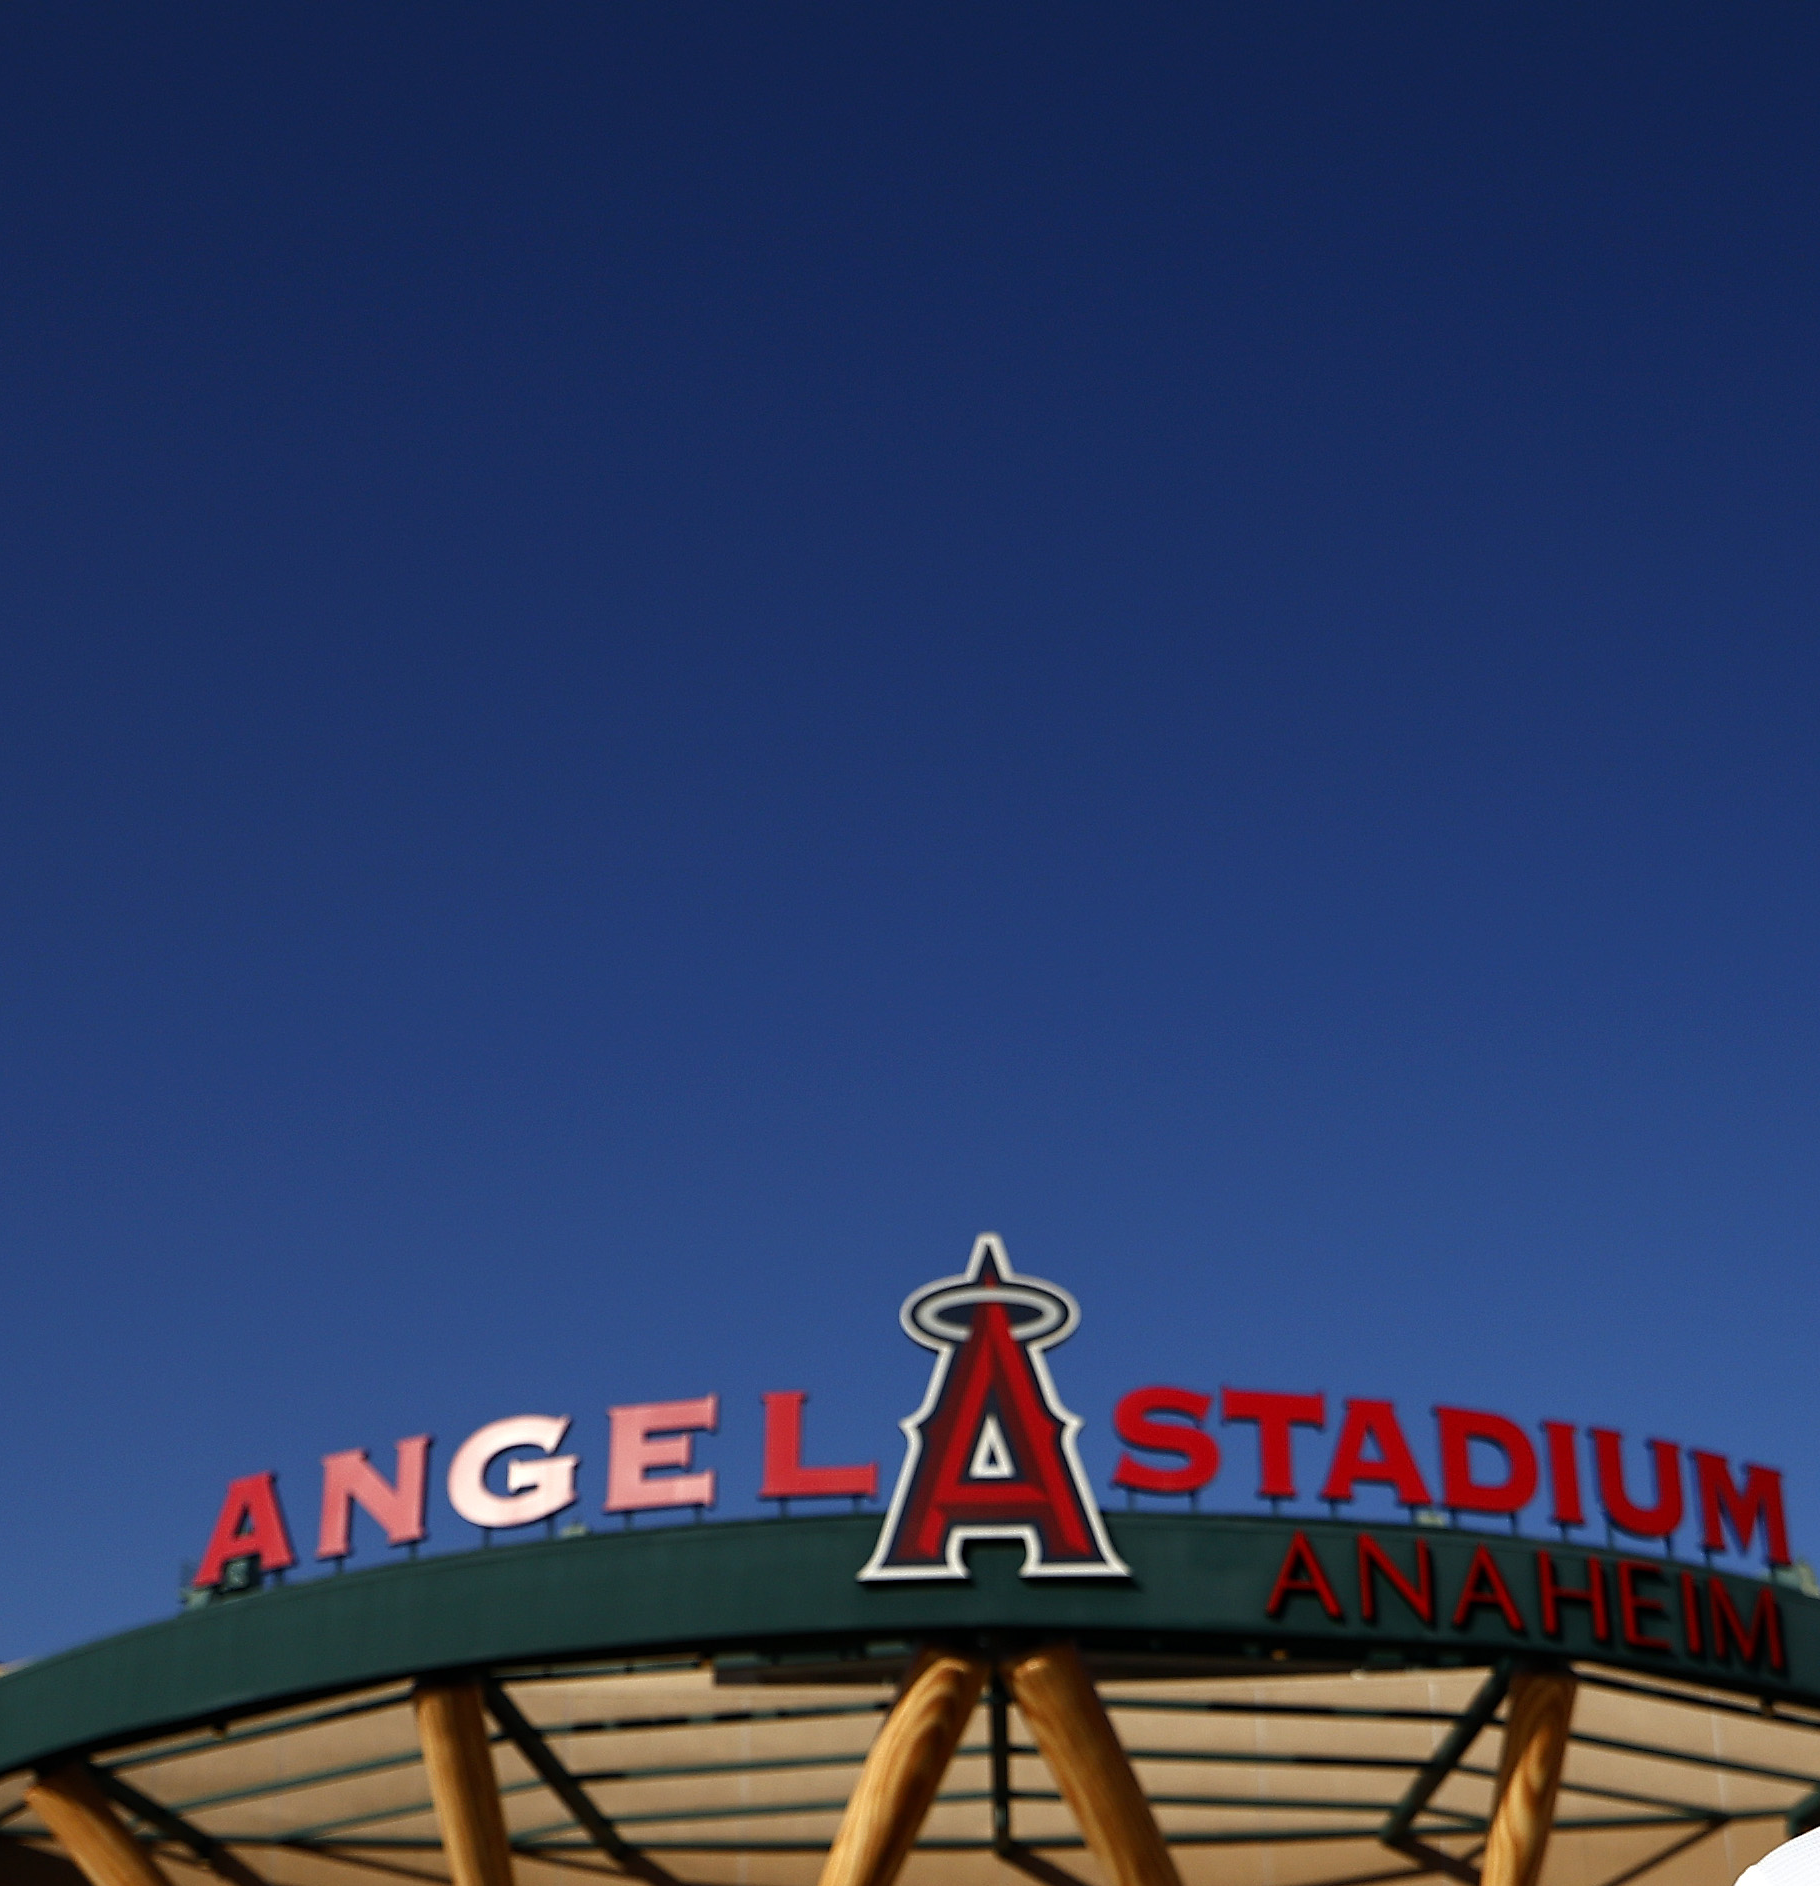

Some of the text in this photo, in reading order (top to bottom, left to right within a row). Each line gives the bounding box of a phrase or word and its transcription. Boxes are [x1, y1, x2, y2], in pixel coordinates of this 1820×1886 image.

[192, 1384, 1793, 1588] ANGEL STADIUM
[1263, 1529, 1787, 1671] ANAHEIM
